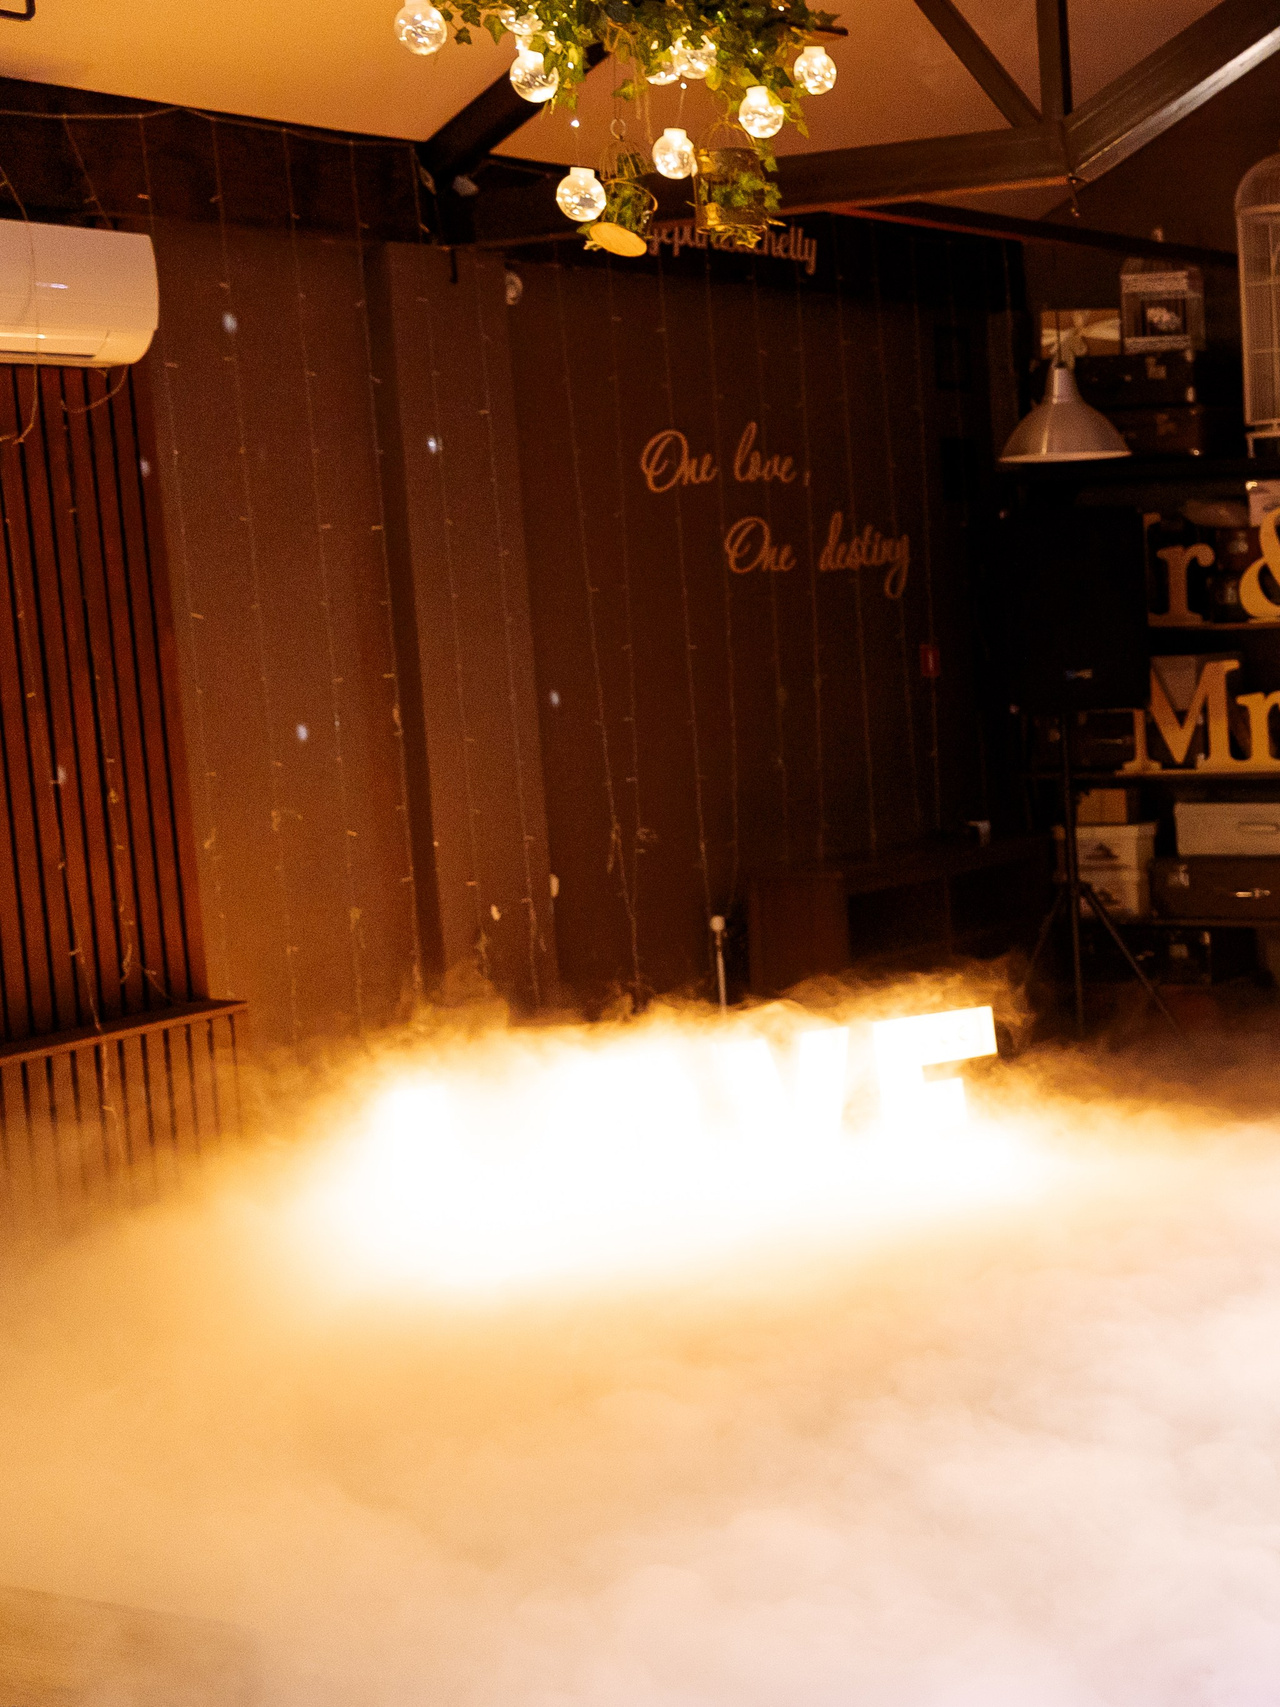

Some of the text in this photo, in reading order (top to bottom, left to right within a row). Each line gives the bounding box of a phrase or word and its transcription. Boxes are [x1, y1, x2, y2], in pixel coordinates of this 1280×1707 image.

[641, 430, 717, 493] One
[724, 511, 910, 599] One destiny
